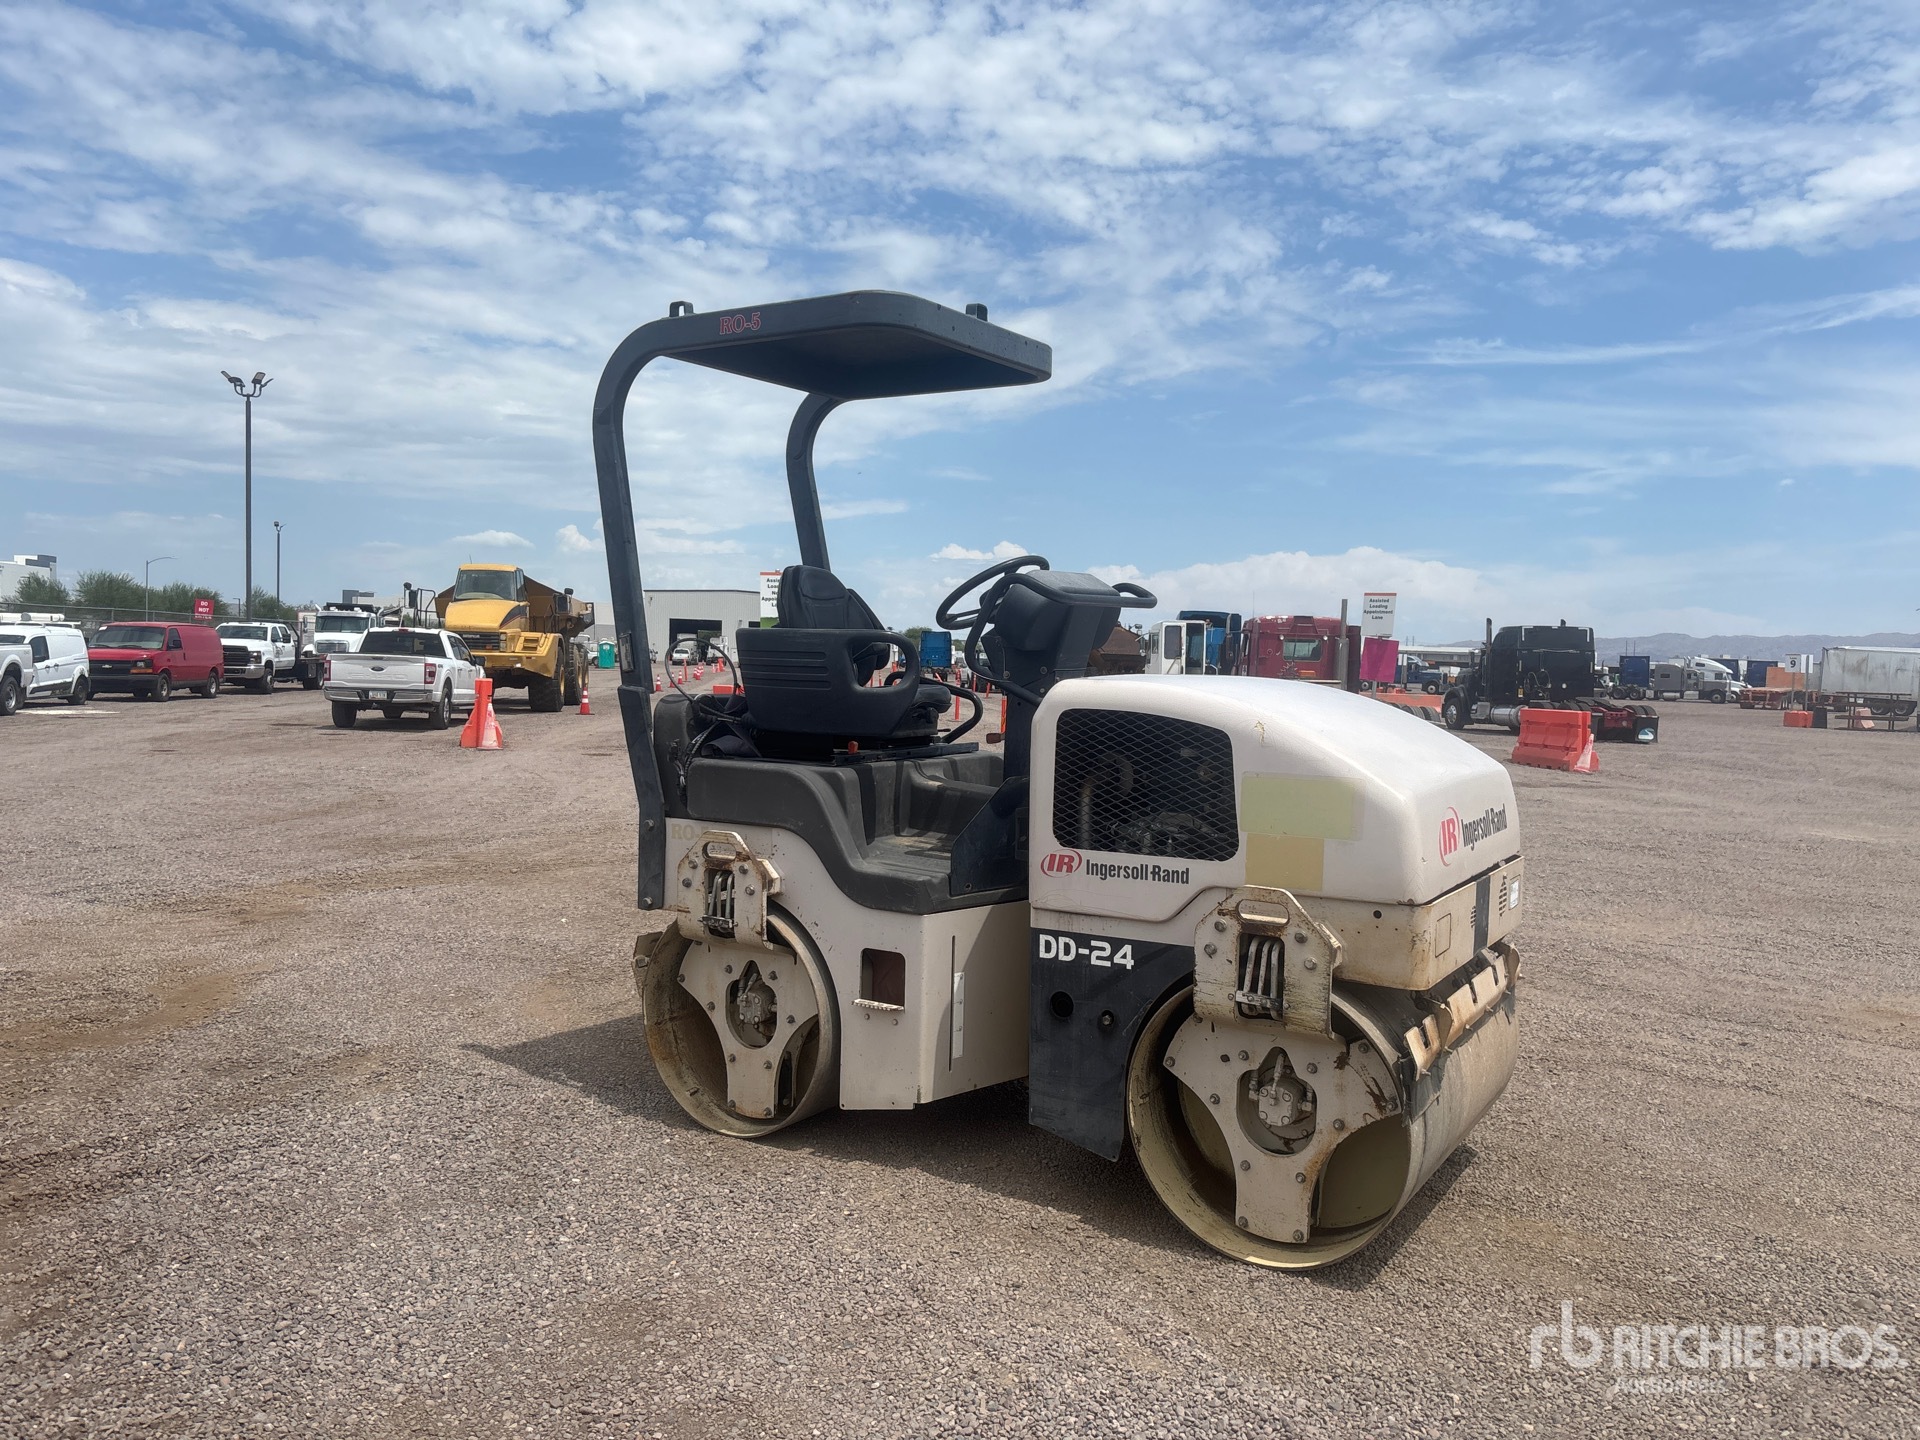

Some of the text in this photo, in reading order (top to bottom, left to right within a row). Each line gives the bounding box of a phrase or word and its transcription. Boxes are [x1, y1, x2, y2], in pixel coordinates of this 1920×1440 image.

[720, 312, 761, 334] RO-5
[1790, 660, 1796, 668] 9
[1440, 816, 1458, 857] IR
[1046, 853, 1076, 874] IR
[1039, 934, 1135, 970] DD-24
